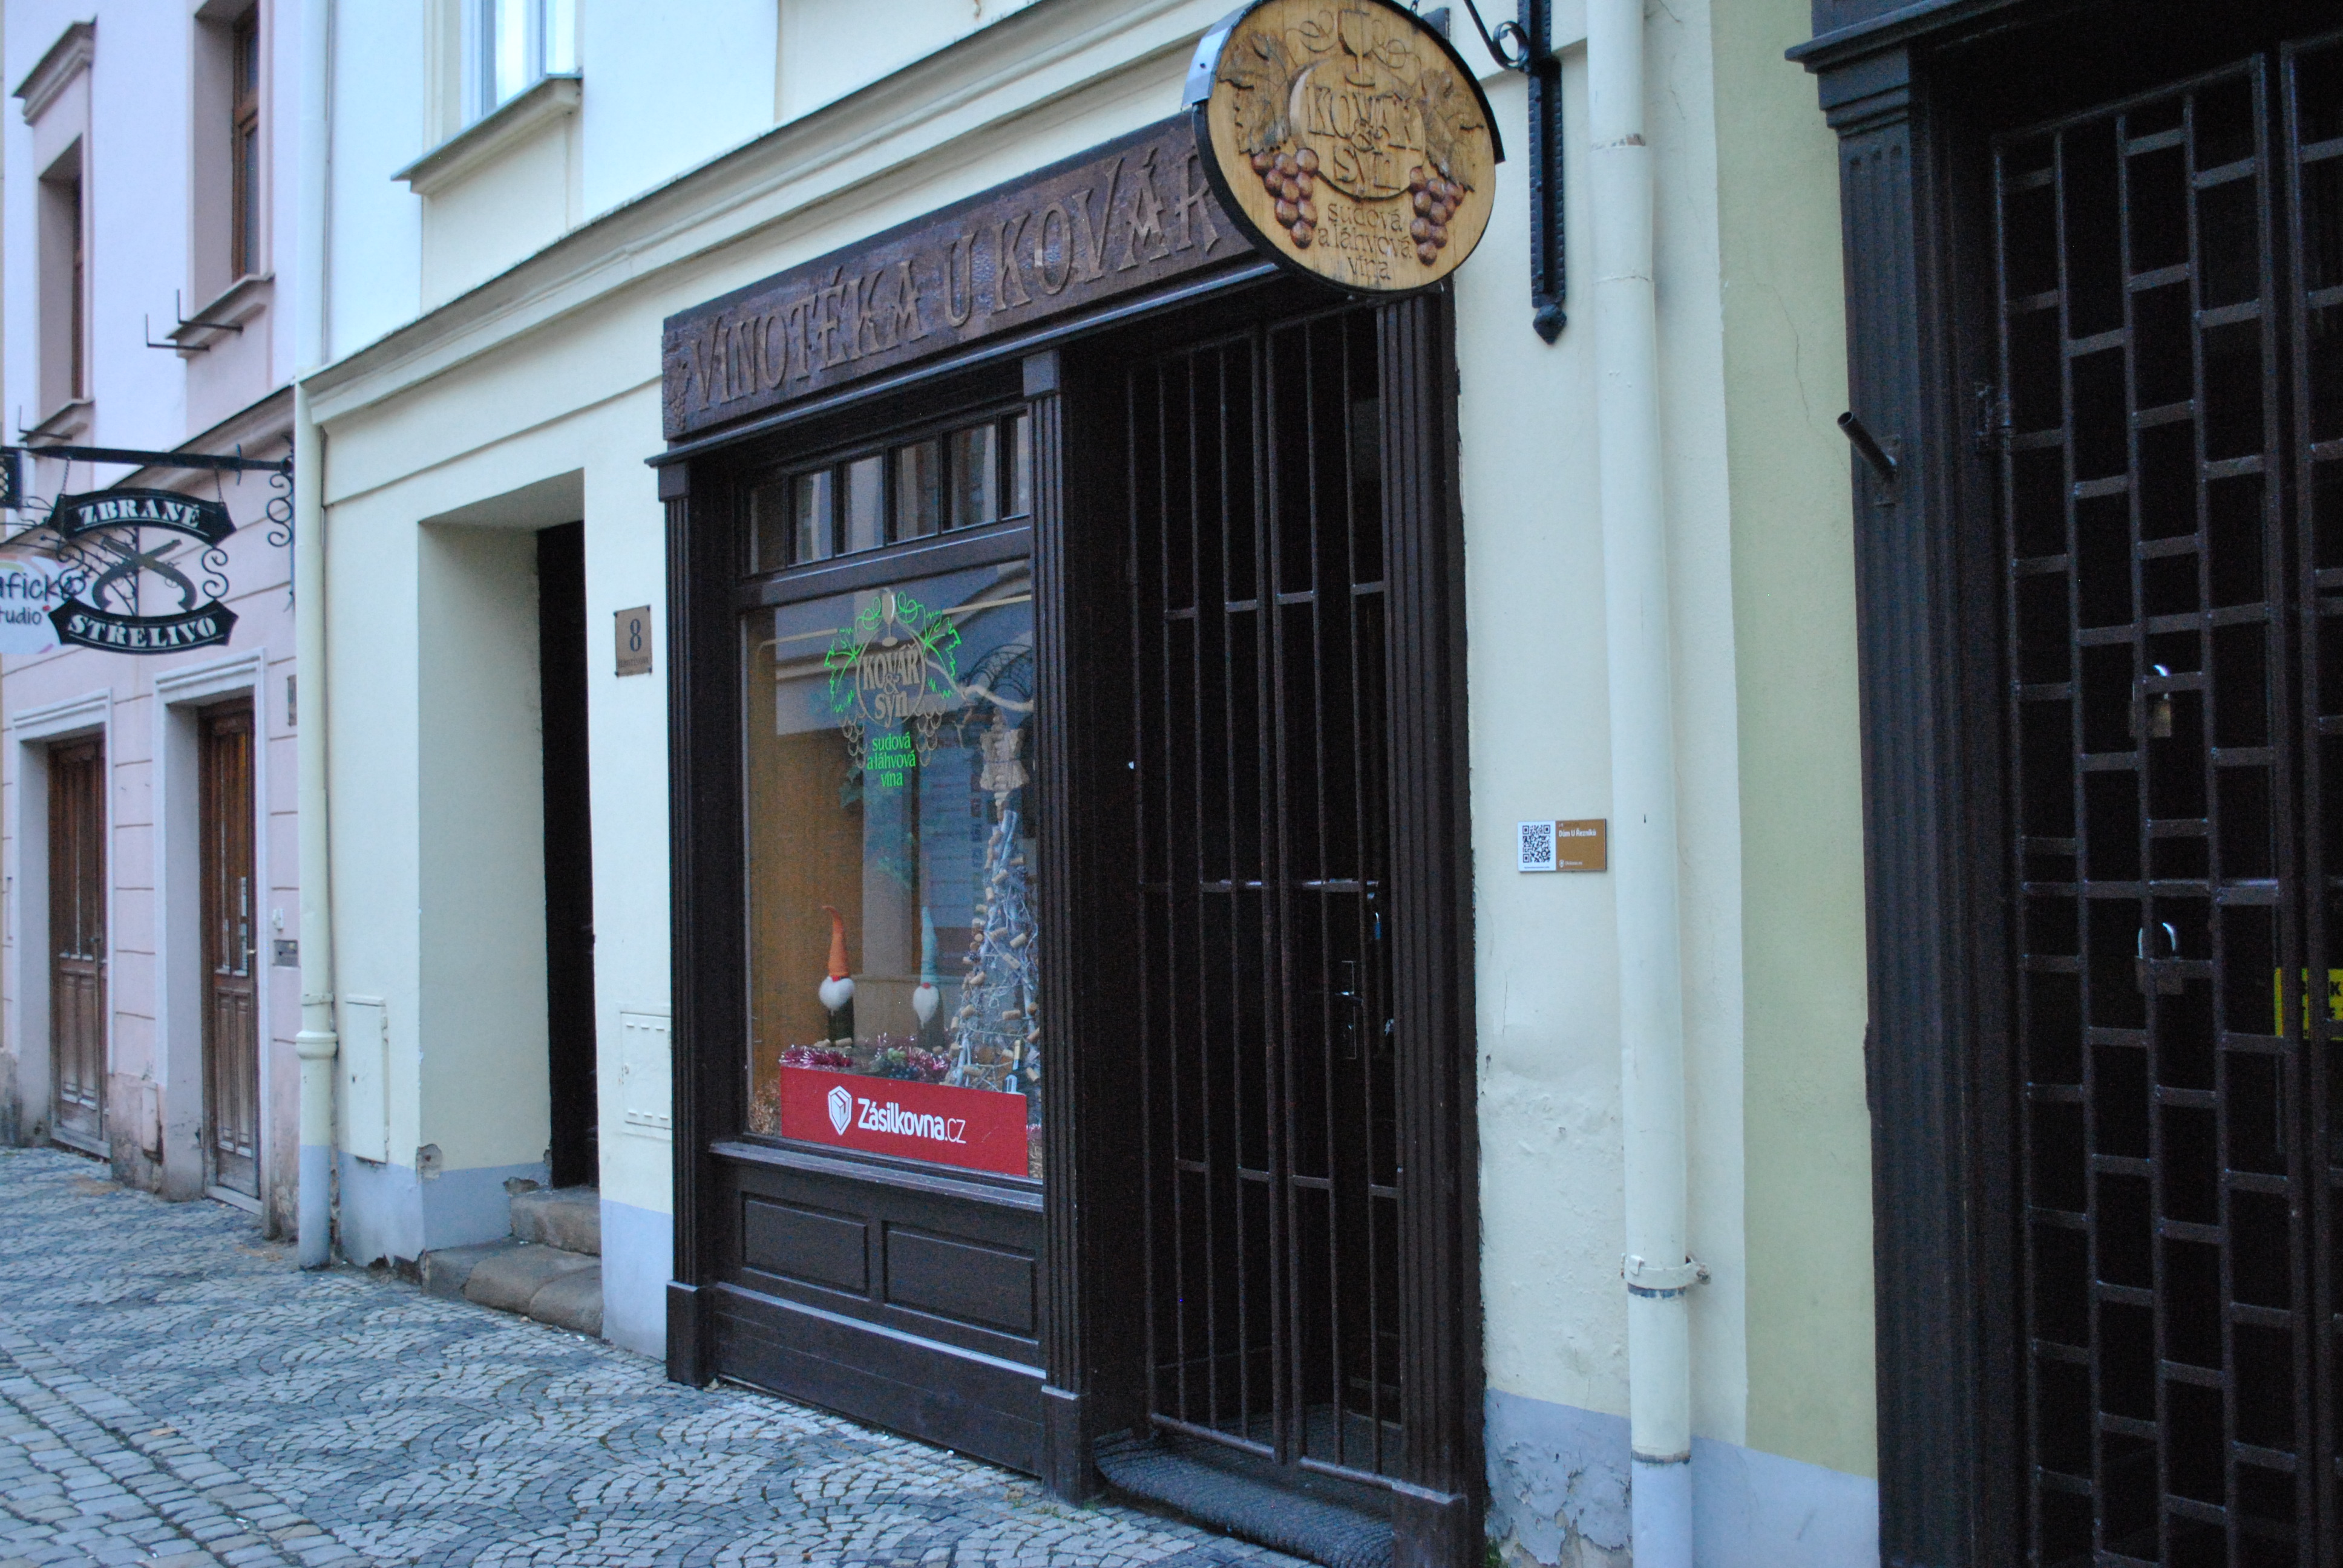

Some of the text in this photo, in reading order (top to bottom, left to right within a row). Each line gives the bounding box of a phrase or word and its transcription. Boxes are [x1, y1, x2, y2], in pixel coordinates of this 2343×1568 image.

[1328, 203, 1403, 232] sudová
[1347, 255, 1391, 280] vína
[690, 259, 929, 411] VINOTÉKA
[944, 230, 978, 328] U
[67, 614, 217, 647] STŘELIVO
[630, 618, 641, 652] 8
[862, 643, 920, 690] KOVÁŘ
[884, 673, 900, 695] &
[872, 731, 911, 752] sudová
[880, 771, 903, 787] vína
